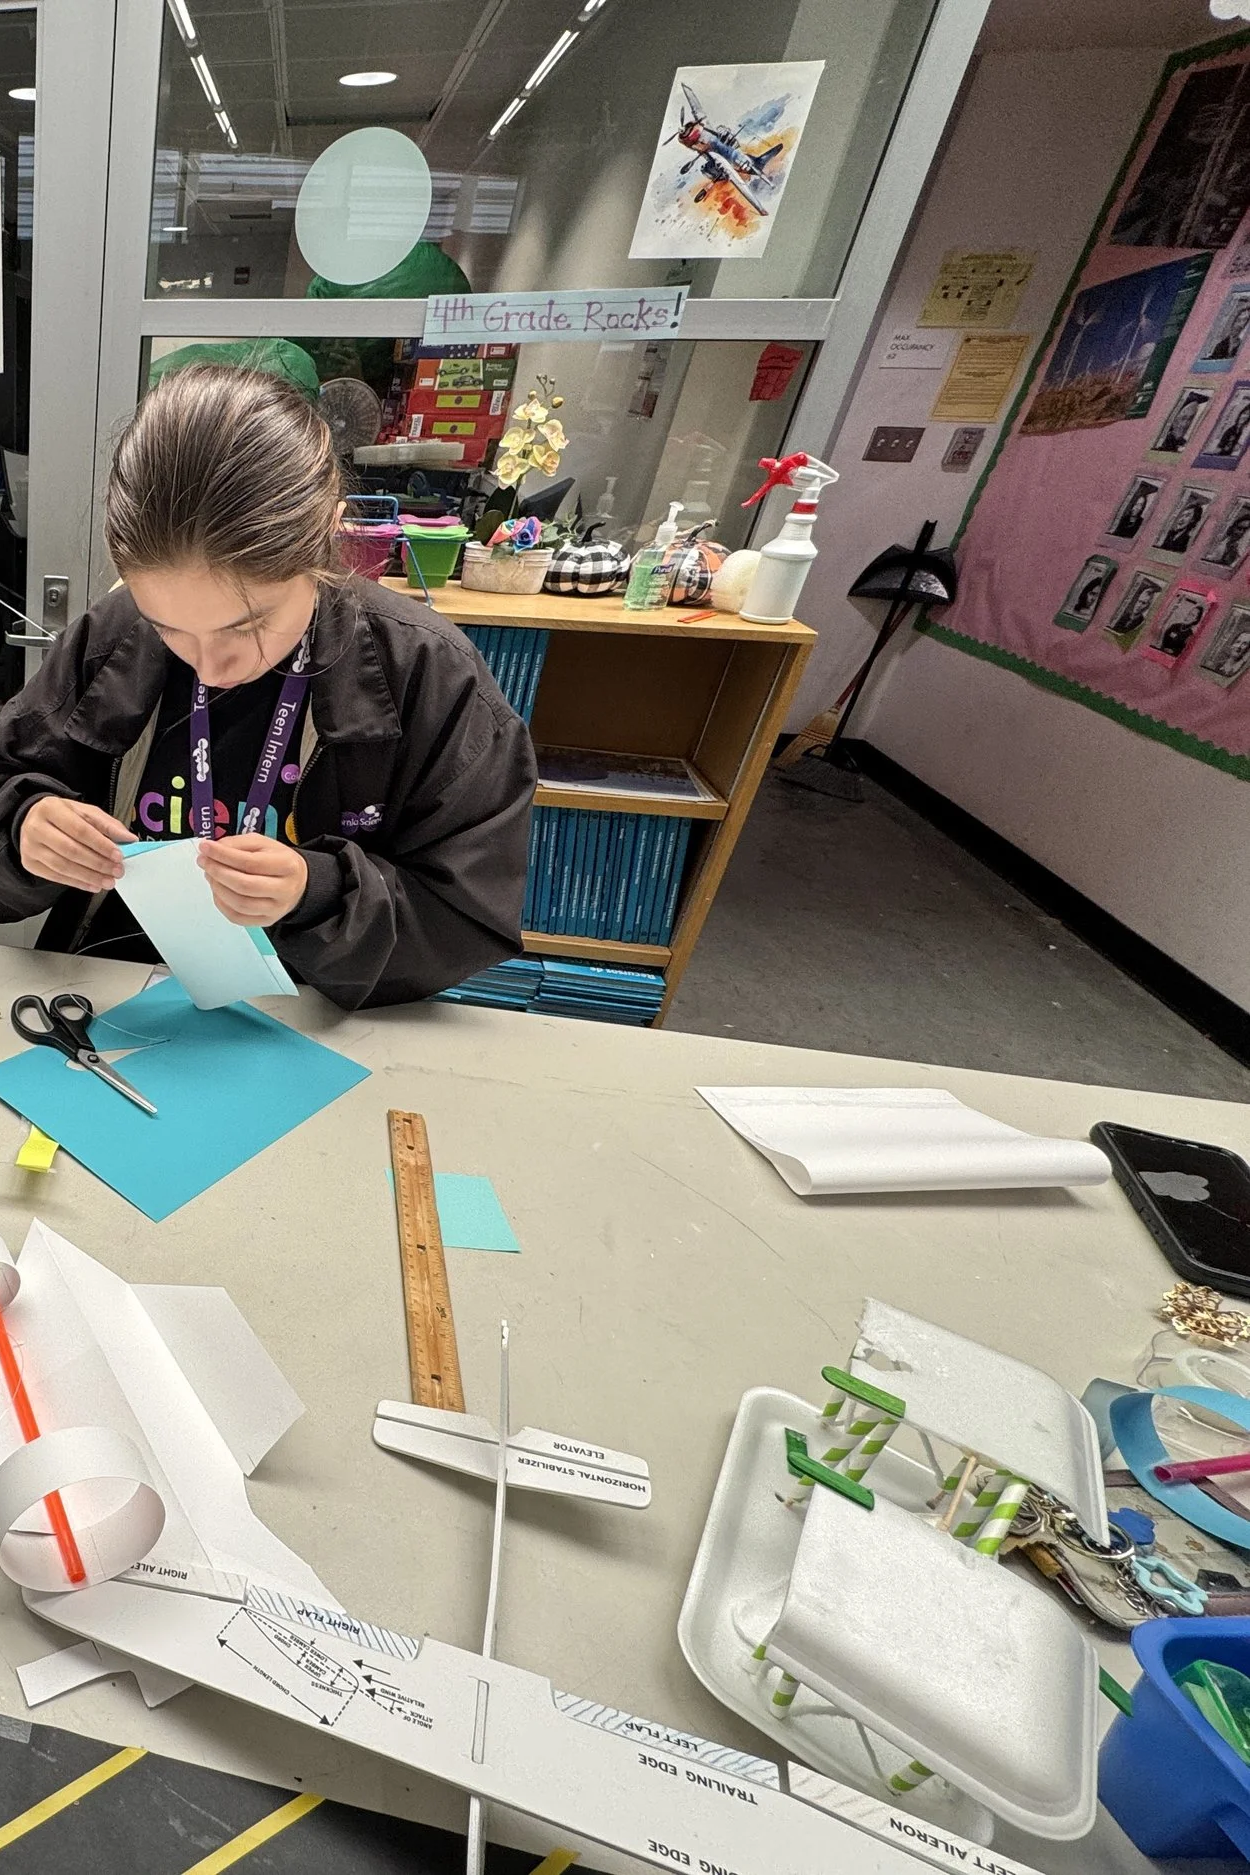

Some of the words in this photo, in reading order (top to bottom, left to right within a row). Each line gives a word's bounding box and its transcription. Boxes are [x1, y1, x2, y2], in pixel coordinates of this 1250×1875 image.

[433, 297, 474, 333] 4th
[483, 300, 572, 332] Grade
[583, 292, 683, 332] Rocks!
[194, 683, 206, 711] Tee
[273, 701, 297, 736] Teen
[258, 737, 284, 784] Intern
[553, 1441, 605, 1460] ELEVATOR
[517, 1457, 575, 1476] STABILIZER
[577, 1470, 646, 1493] HORIZONTAL
[130, 1561, 155, 1573] AILE
[158, 1567, 188, 1580] RIGHT
[297, 1609, 325, 1625] FLAP
[326, 1617, 361, 1635] RIGHT
[290, 1635, 311, 1650] CAMBER
[311, 1649, 328, 1662] LOWER
[252, 1665, 272, 1682] LENGTH
[304, 1664, 321, 1678] UPPER
[305, 1659, 326, 1675] CAMBER
[272, 1680, 290, 1696] CHORD
[311, 1681, 343, 1697] THICKNESS
[380, 1688, 396, 1698] WIND
[397, 1693, 425, 1708] RELATIVE
[403, 1715, 413, 1723] OF
[410, 1710, 433, 1723] ATTACK
[413, 1718, 432, 1730] ANGLE
[625, 1722, 660, 1739] FLAP
[664, 1737, 699, 1752] LEFT
[638, 1753, 678, 1776] EDGE
[685, 1770, 758, 1806] TRAILING
[889, 1817, 968, 1860] AILERON
[647, 1838, 691, 1866] EDGE
